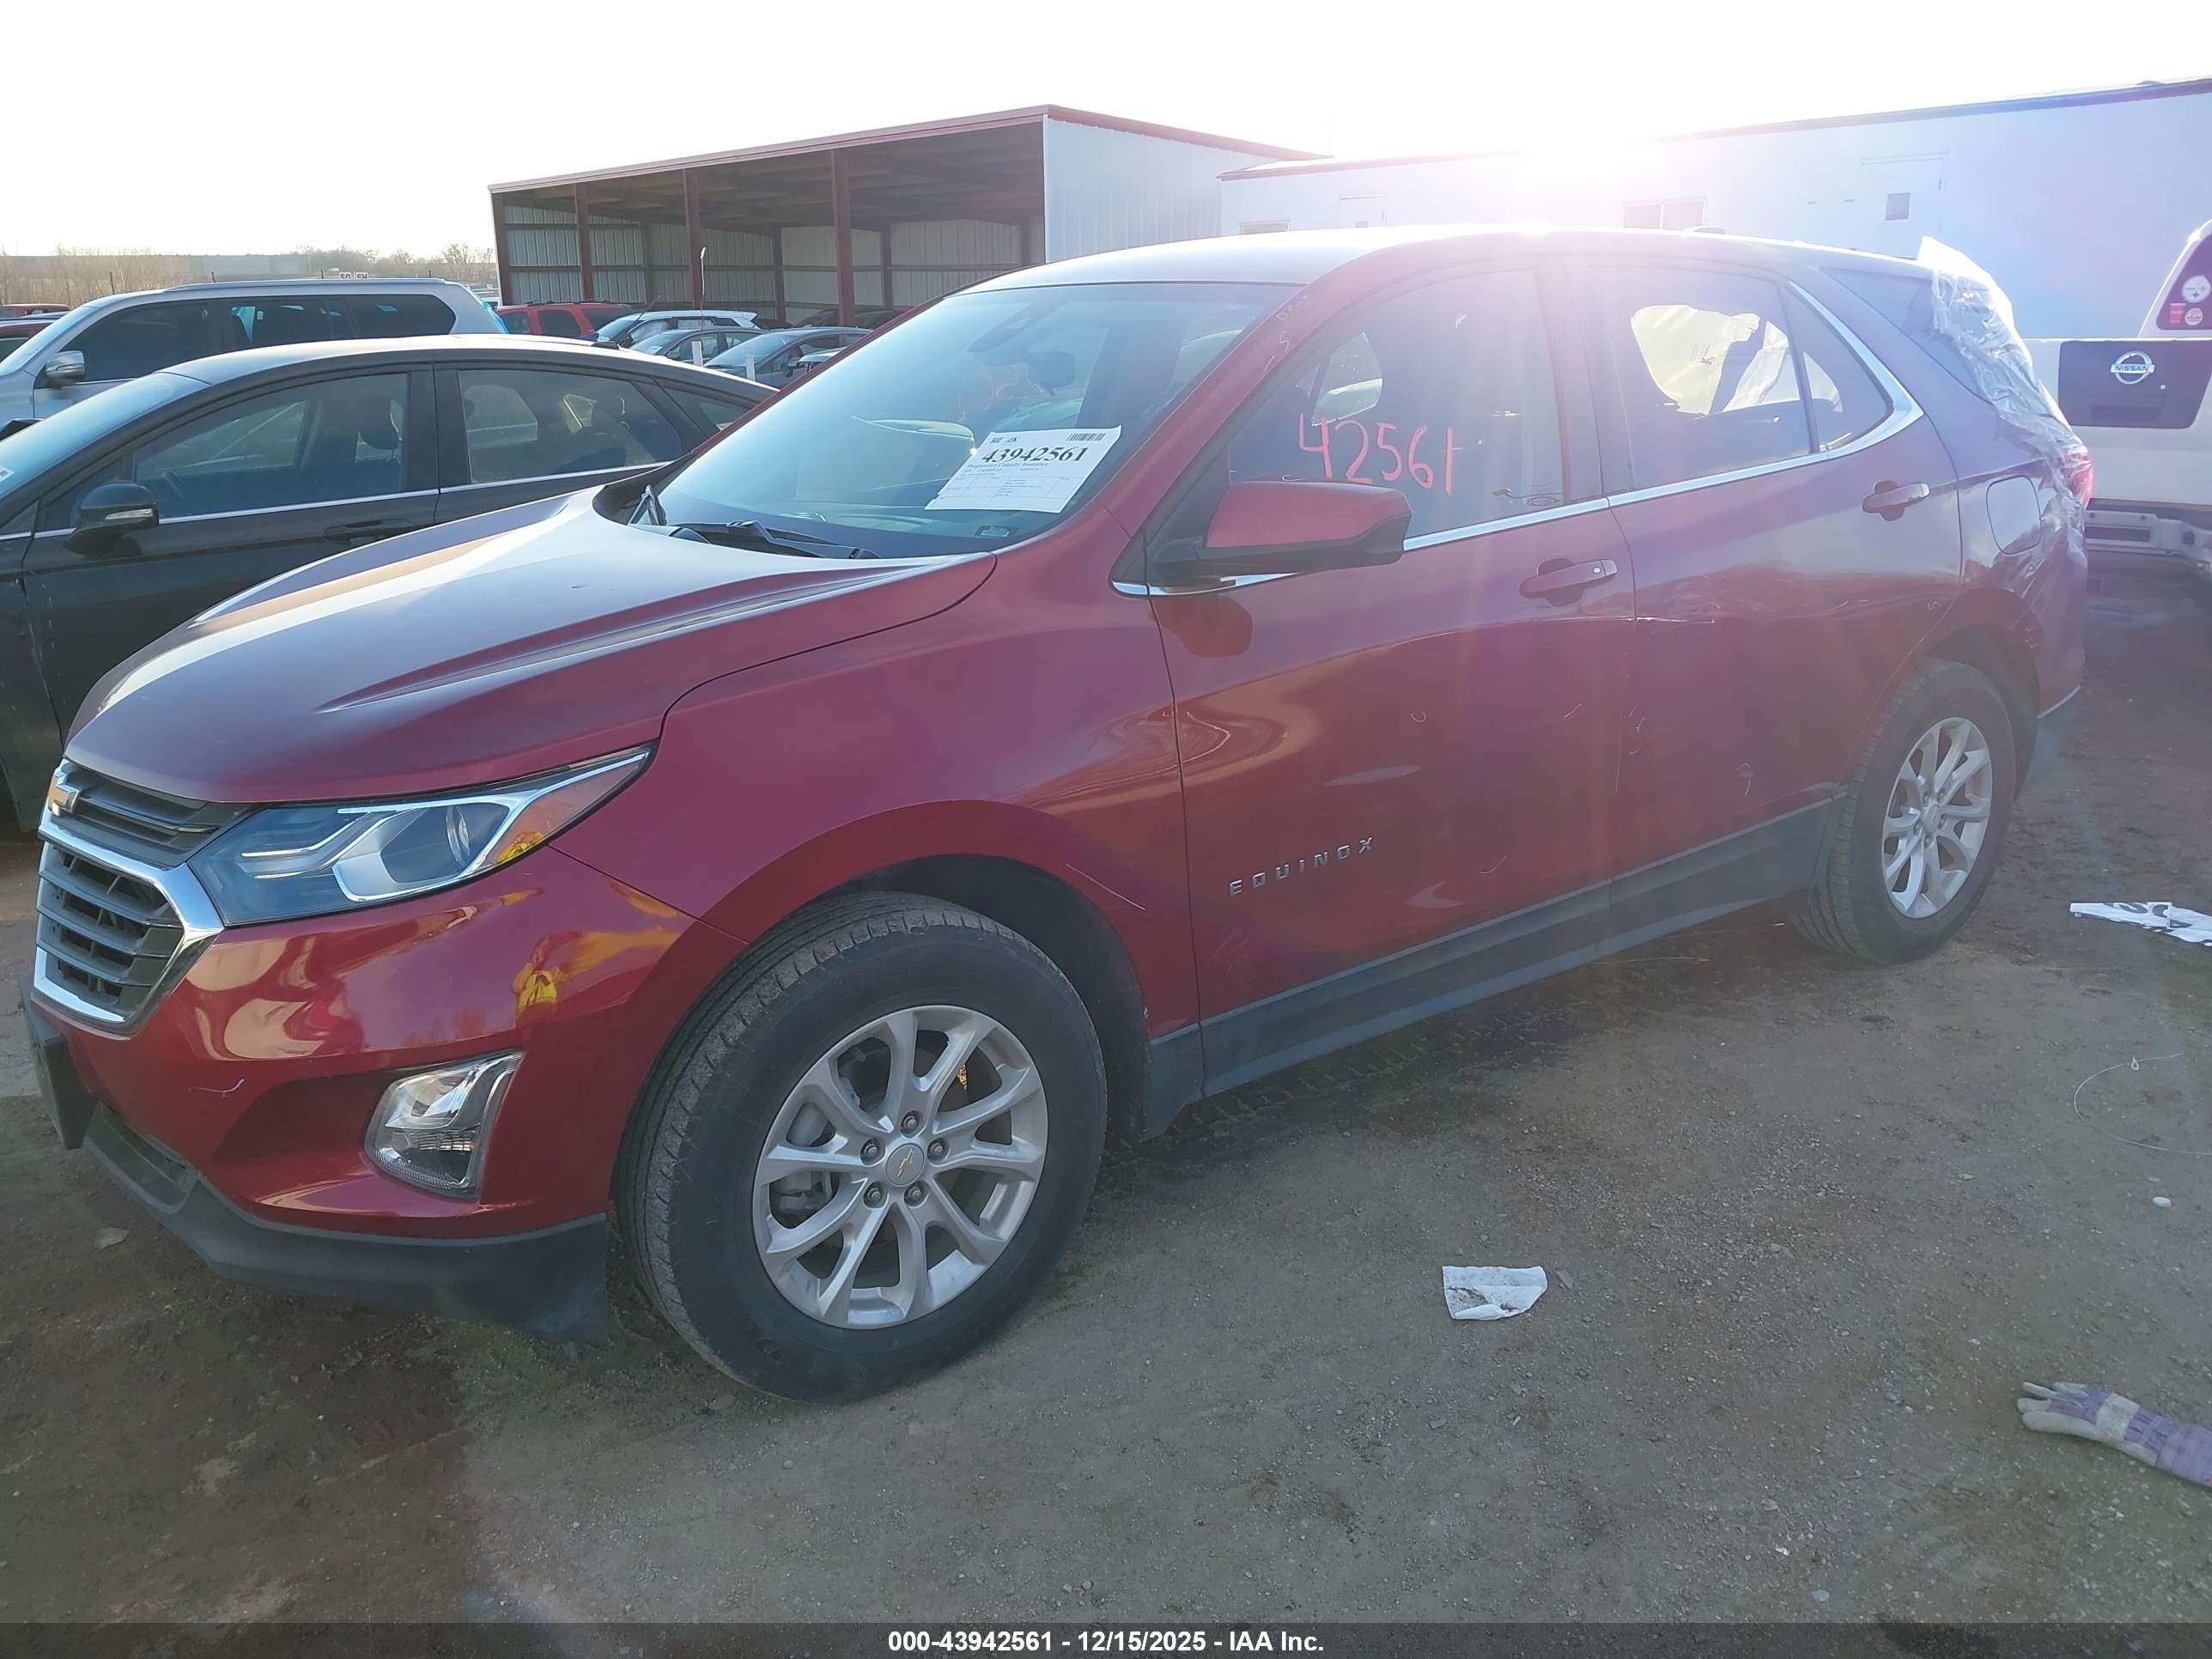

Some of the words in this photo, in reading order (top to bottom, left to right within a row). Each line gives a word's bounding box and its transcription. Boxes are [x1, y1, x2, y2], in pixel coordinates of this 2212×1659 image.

[981, 446, 1089, 463] 43942561
[1298, 412, 1455, 495] 42561
[1229, 836, 1374, 896] EQUINOX
